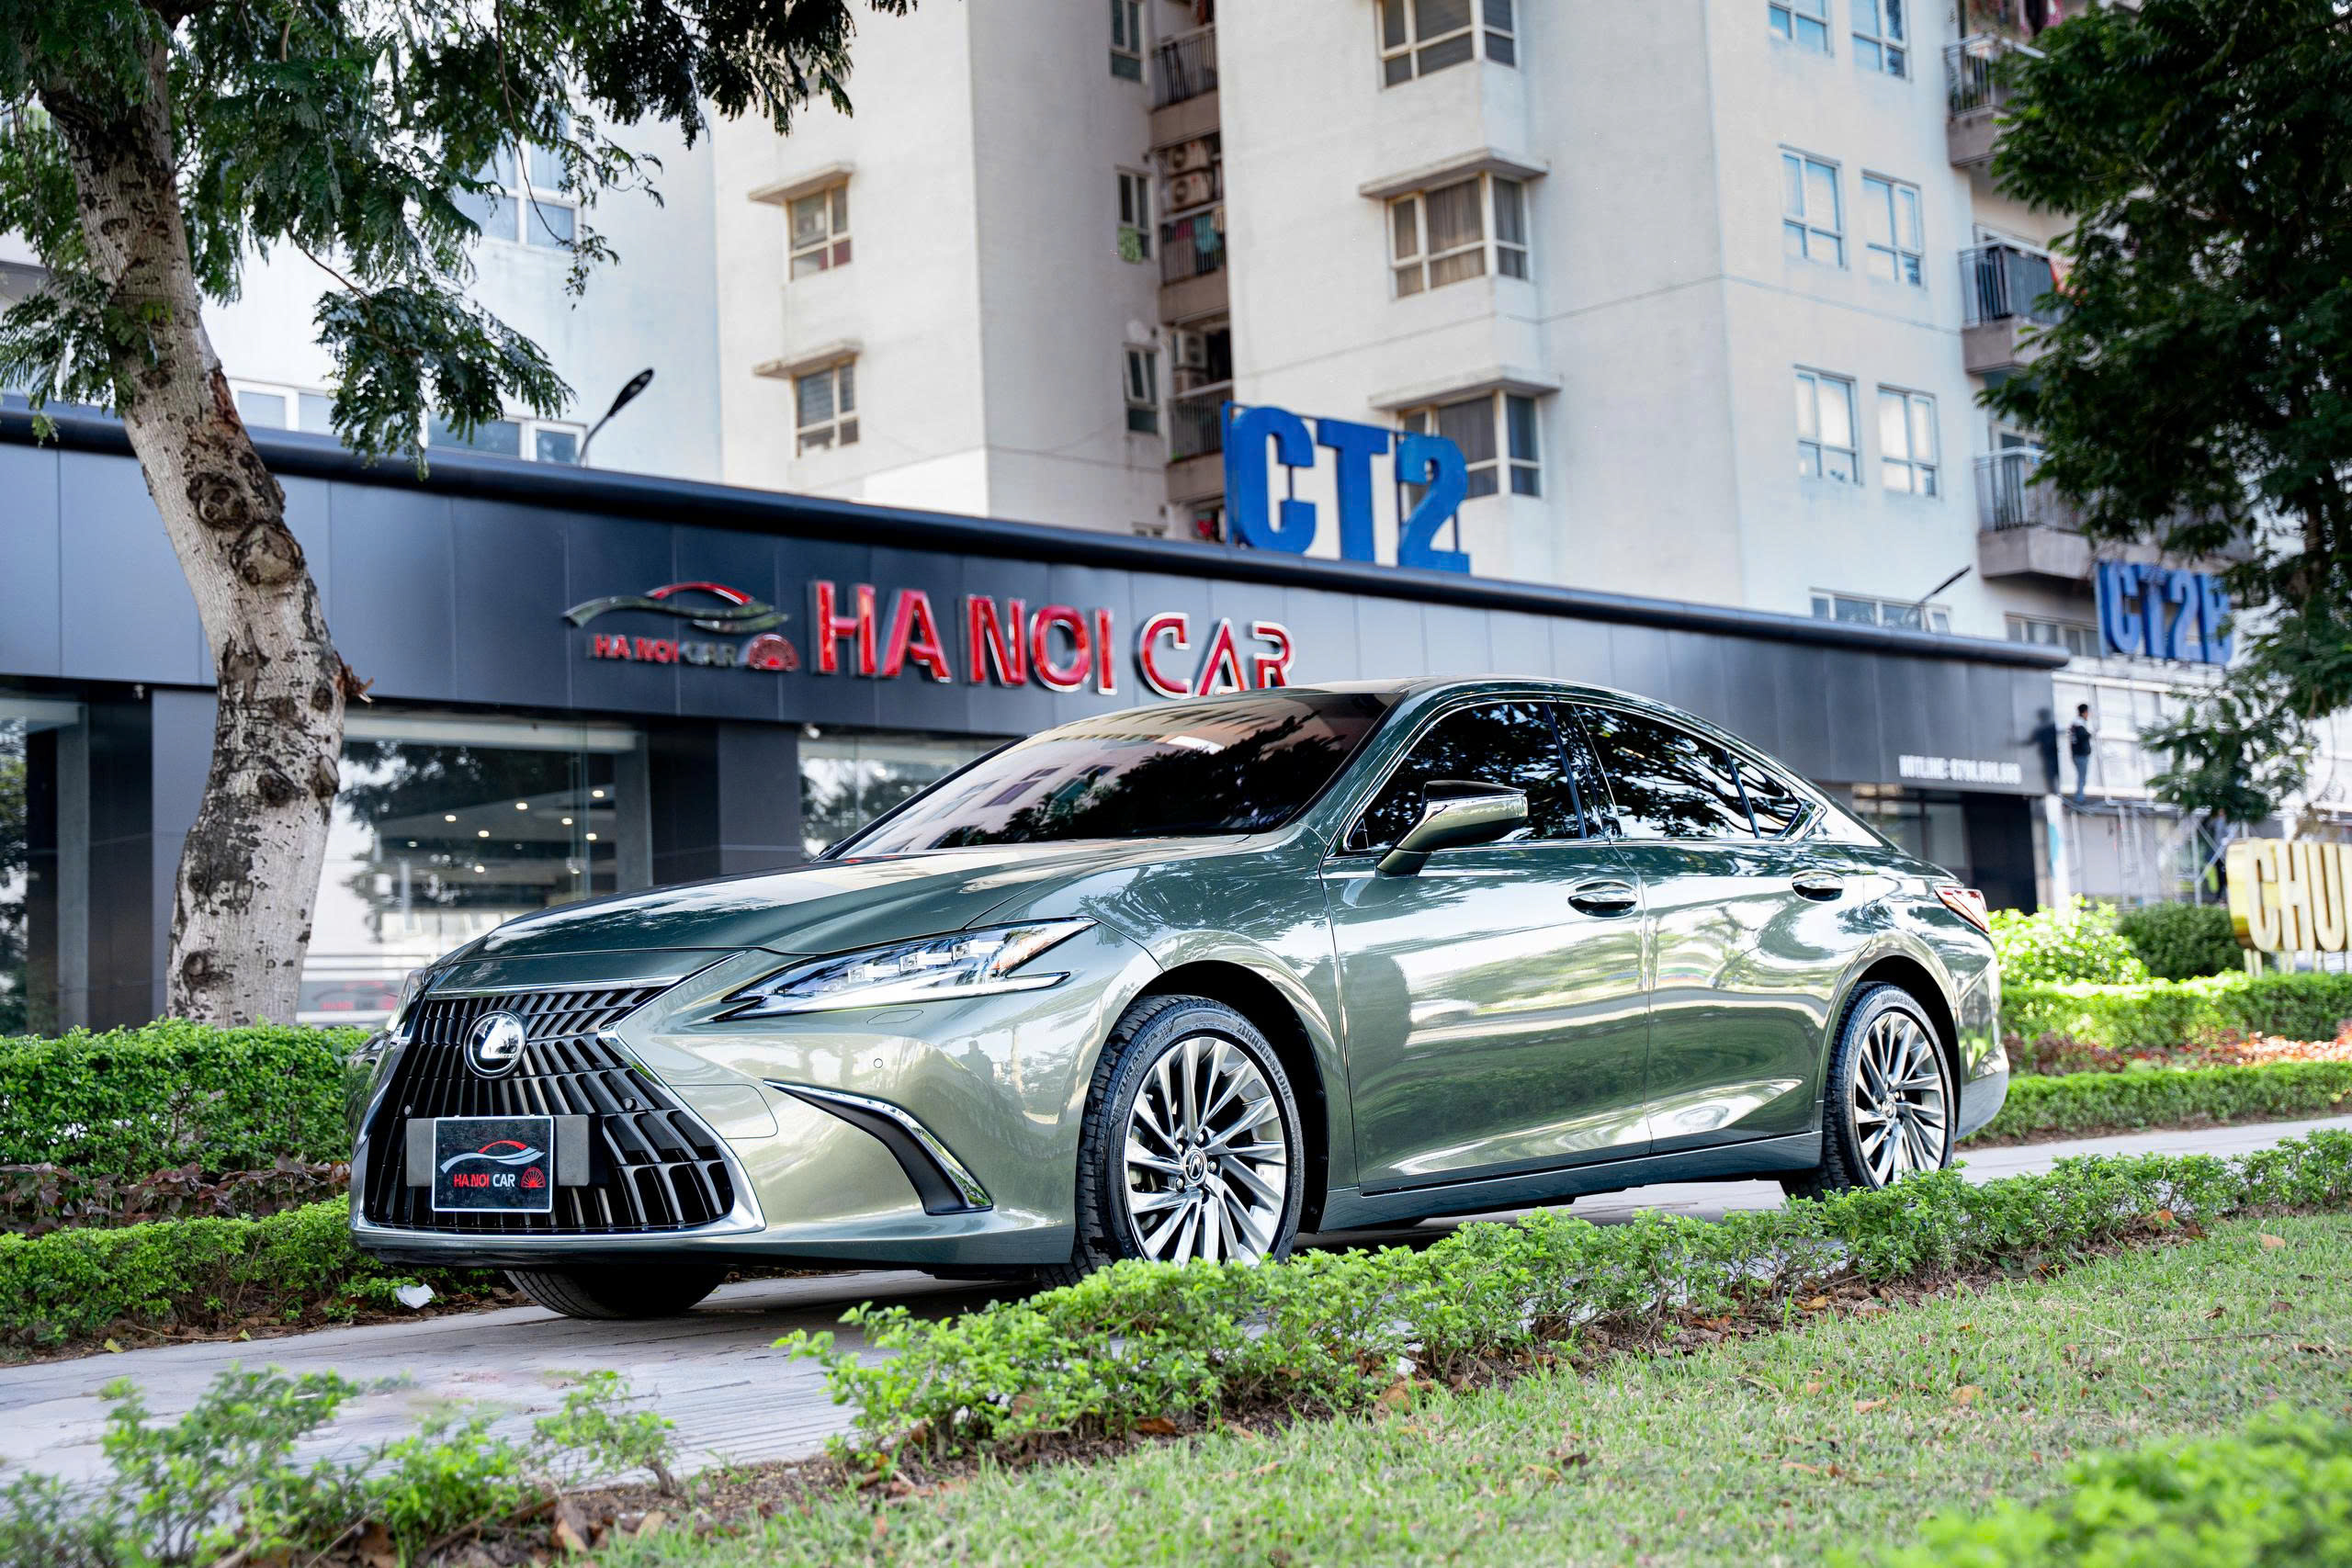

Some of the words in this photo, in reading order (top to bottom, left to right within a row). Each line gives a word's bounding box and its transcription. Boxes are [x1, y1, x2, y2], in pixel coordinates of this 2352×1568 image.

[1227, 404, 1470, 574] CT2
[1134, 611, 1296, 699] CAR
[2227, 837, 2352, 953] CHU
[1117, 1032, 1159, 1097] TURANZA
[1236, 1022, 1294, 1104] BRIDGESTONE
[492, 1174, 515, 1188] CAR
